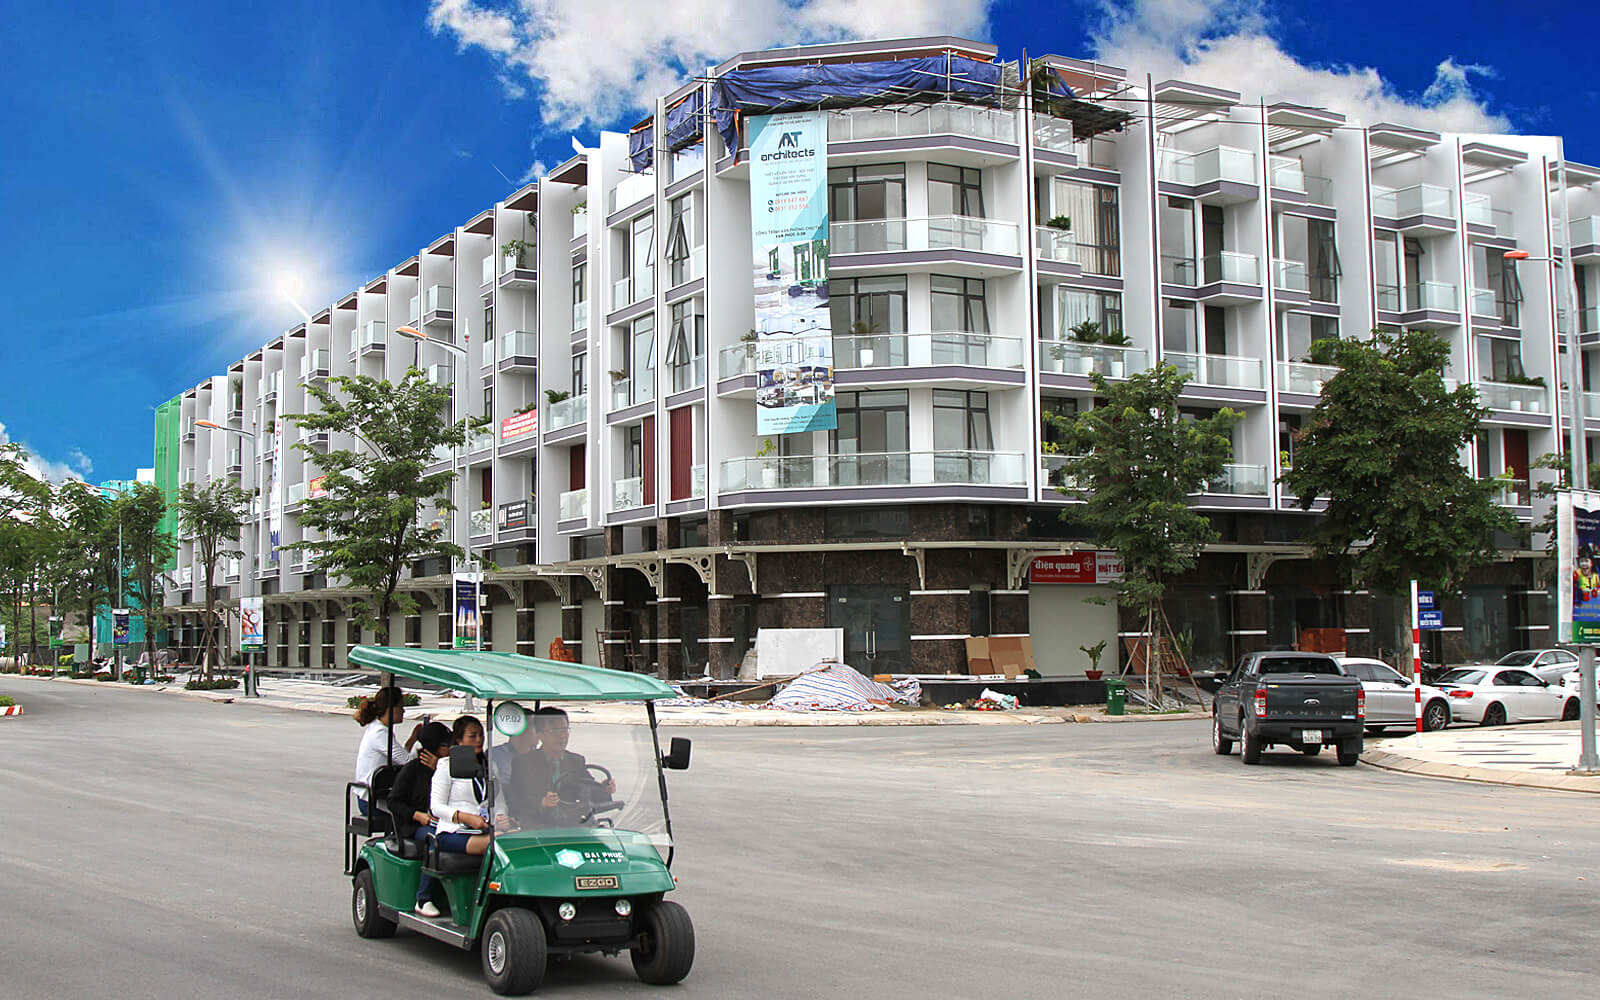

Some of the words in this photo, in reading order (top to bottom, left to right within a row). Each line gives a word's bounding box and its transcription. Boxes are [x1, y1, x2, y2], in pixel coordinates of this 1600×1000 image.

[778, 131, 802, 149] AT
[760, 148, 816, 161] architects
[1035, 560, 1054, 571] điện
[1055, 562, 1080, 573] quang
[500, 714, 521, 723] VP.02
